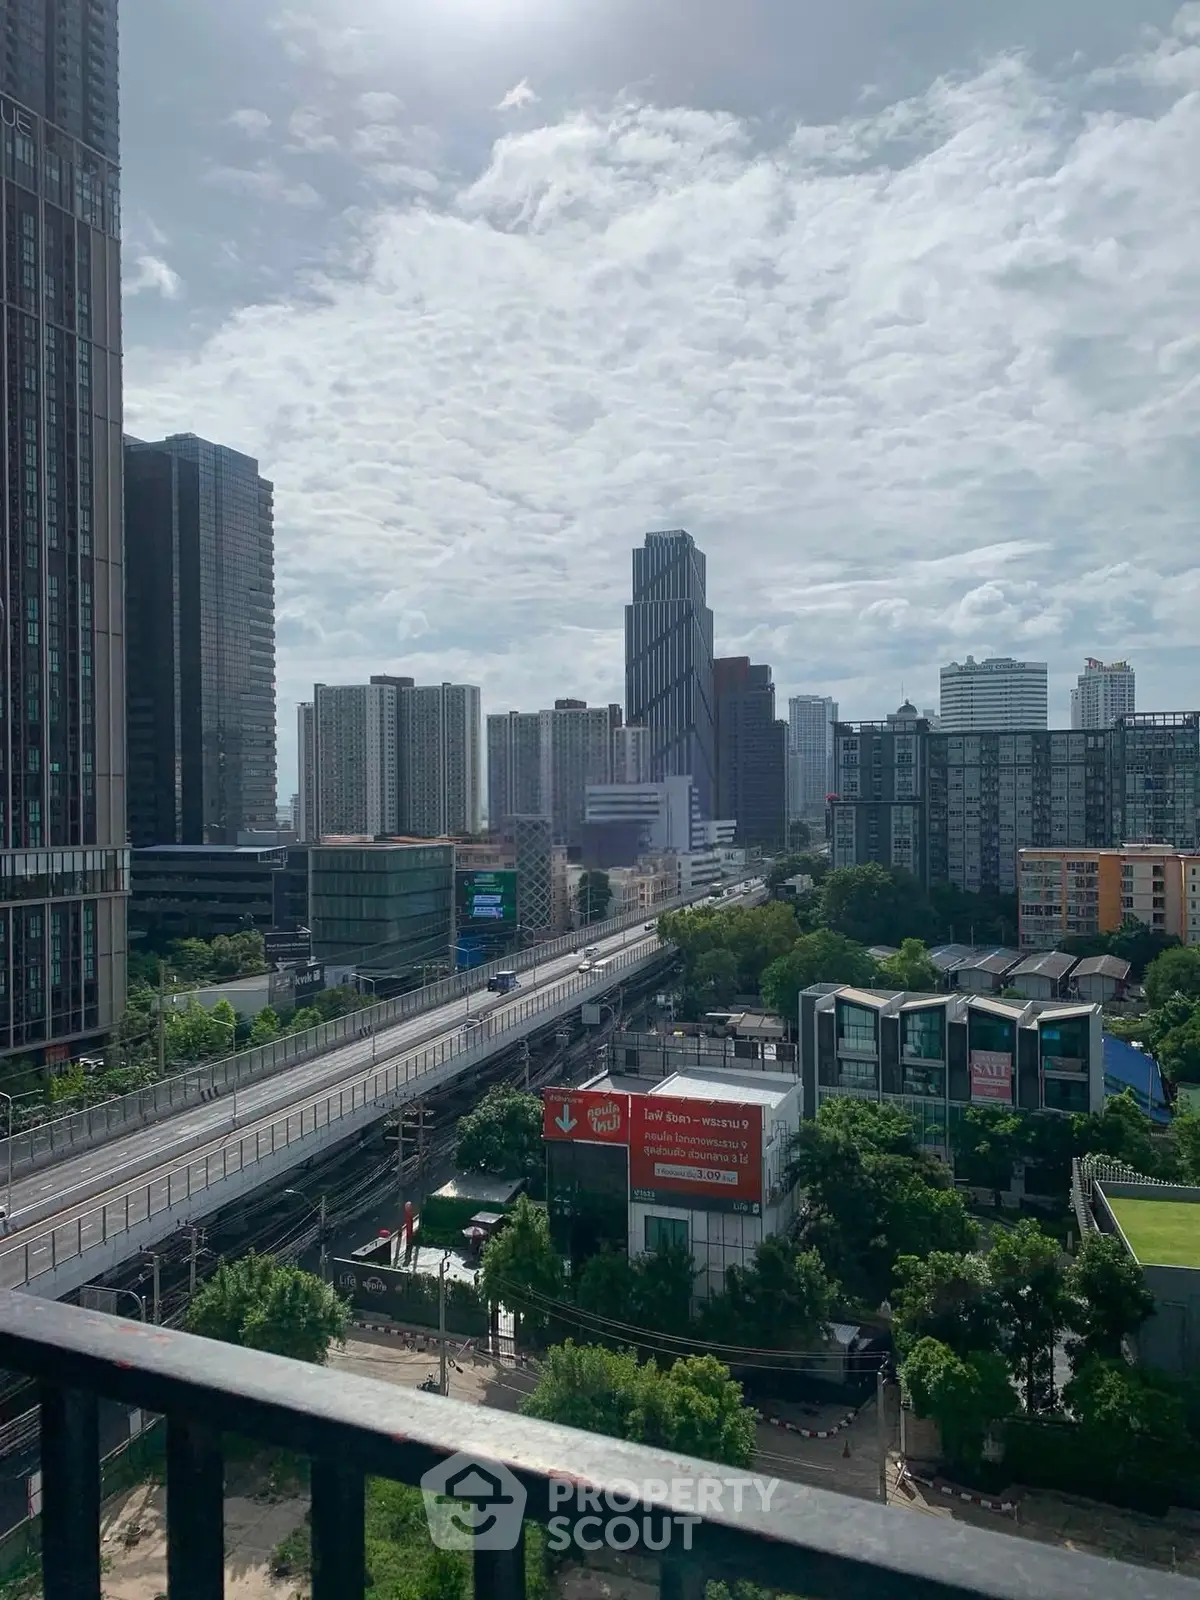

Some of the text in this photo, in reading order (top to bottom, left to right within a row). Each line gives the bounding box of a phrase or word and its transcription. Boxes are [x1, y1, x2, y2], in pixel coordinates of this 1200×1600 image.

[295, 973, 312, 985] kvik
[702, 1117, 740, 1129] พระราม
[696, 1169, 721, 1181] 3.09
